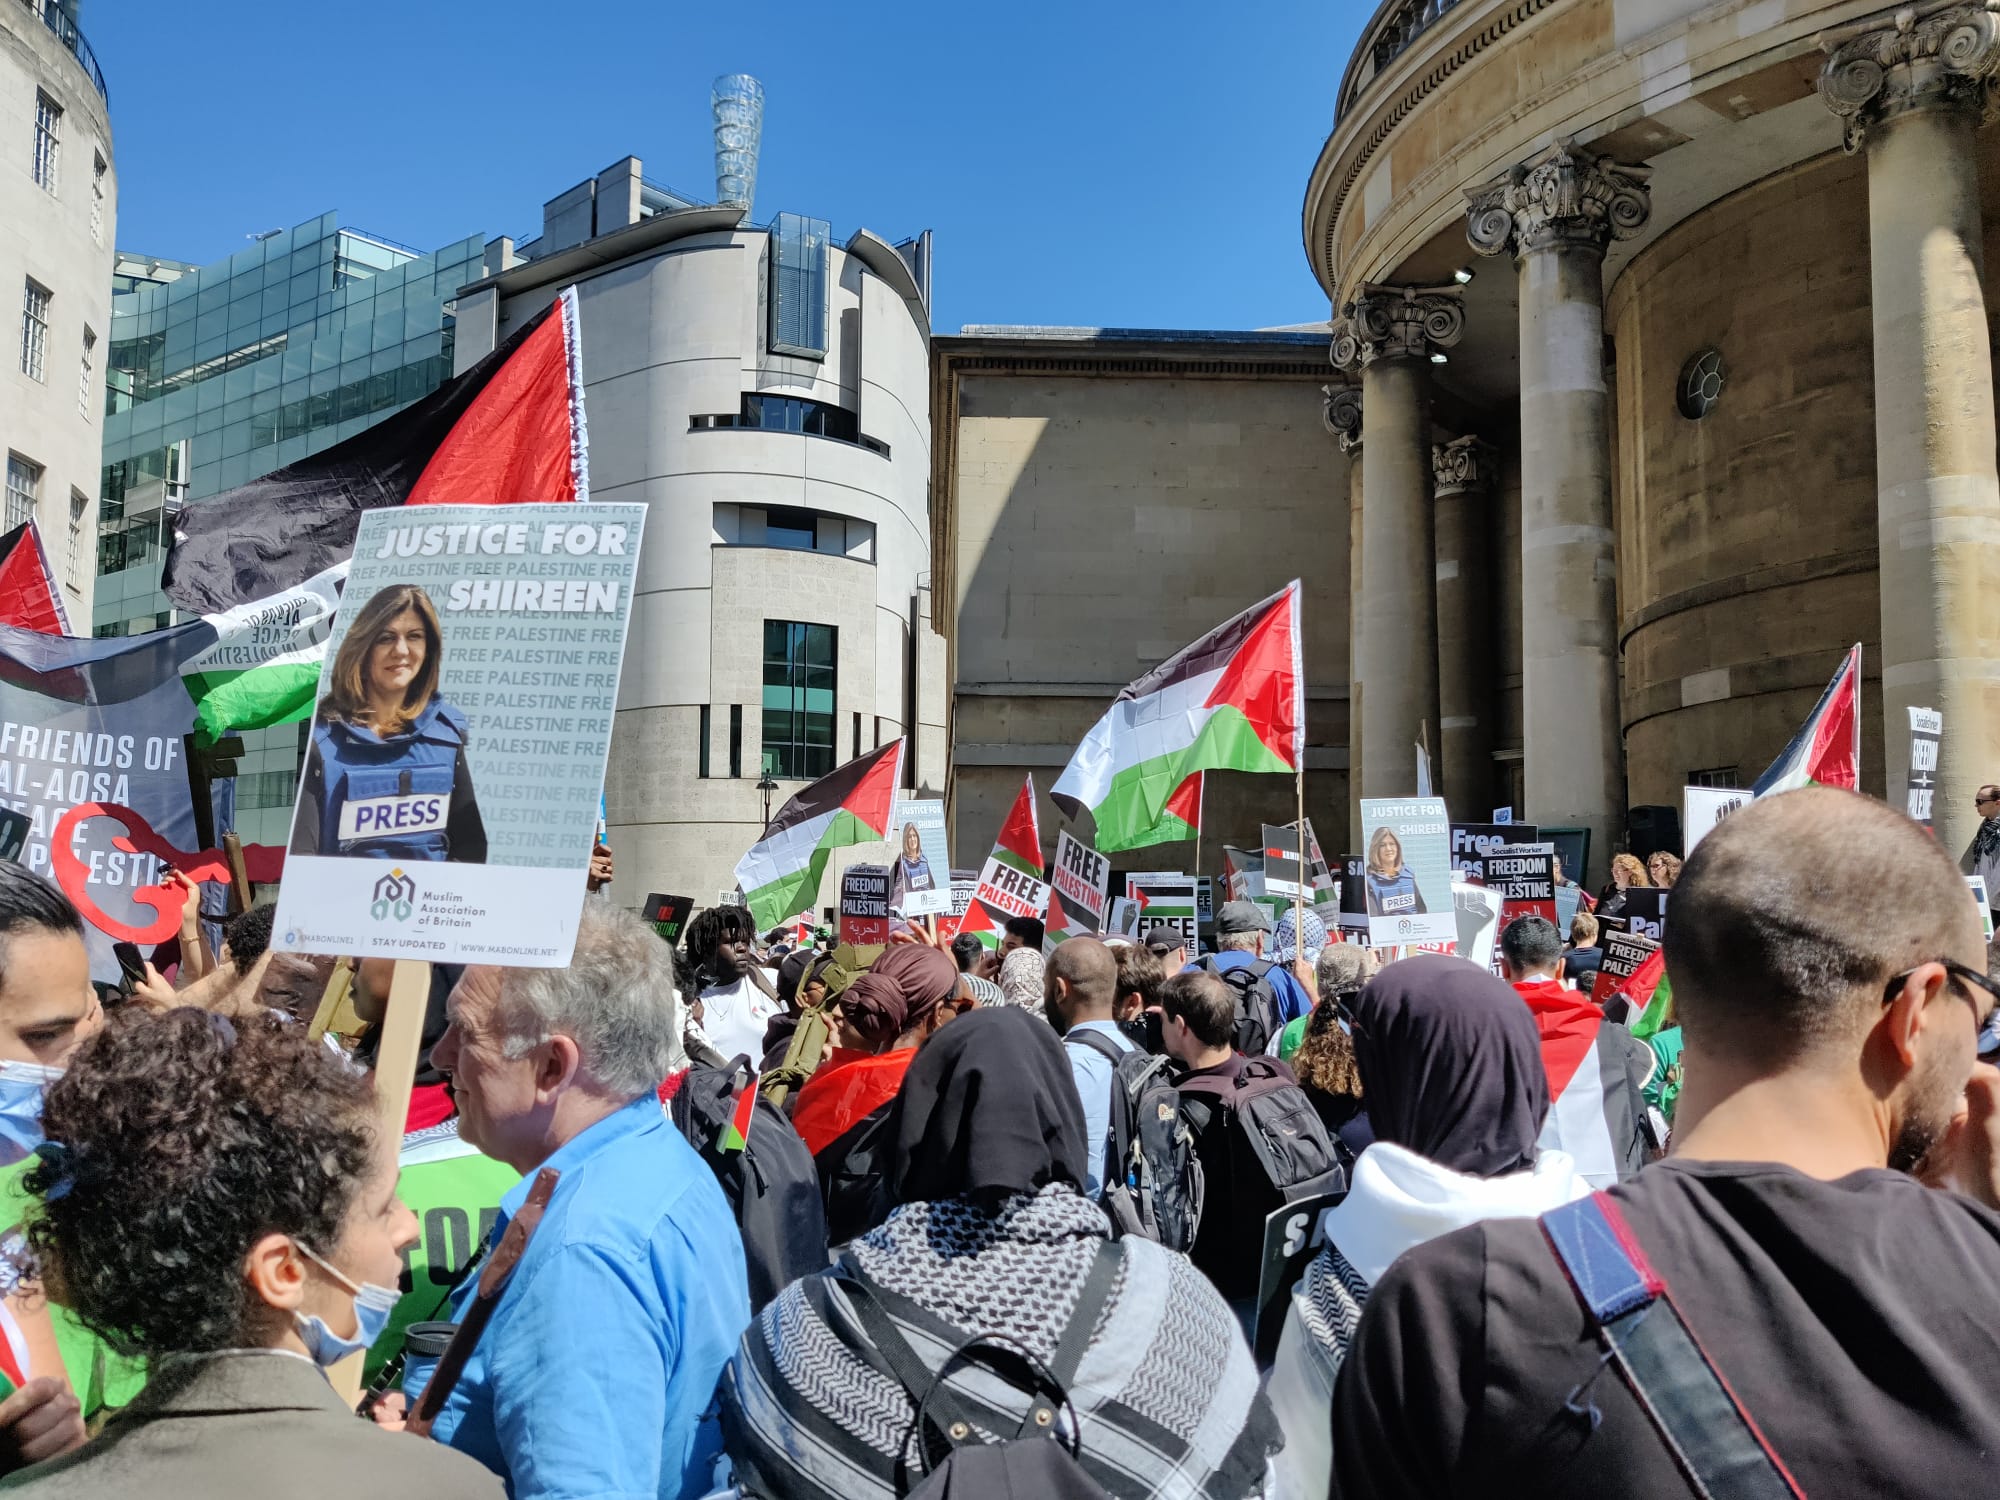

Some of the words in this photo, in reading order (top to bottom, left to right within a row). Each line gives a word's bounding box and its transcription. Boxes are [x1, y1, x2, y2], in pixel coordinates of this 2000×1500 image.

[378, 525, 528, 559] JUSTICE
[541, 524, 628, 556] FOR
[379, 562, 459, 578] PALESTINE
[464, 562, 502, 576] FREE
[507, 562, 597, 577] PALESTINE
[447, 579, 619, 613] SHIREEN
[452, 626, 492, 642] FREE
[495, 626, 587, 643] PALESTINE
[448, 648, 488, 662] FREE
[491, 649, 584, 665] PALESTINE
[444, 669, 484, 684] FREE
[487, 670, 580, 687] PALESTINE
[484, 692, 578, 710] PALESTINE
[480, 714, 574, 732] PALESTINE
[1, 721, 135, 769] FRIENDS
[144, 736, 179, 771] OF
[476, 737, 571, 756] PALESTINE
[473, 760, 567, 779] PALESTINE
[0, 760, 130, 807] AL-AQSA
[355, 799, 440, 833] PRESS
[902, 806, 928, 815] JUSTICE
[929, 805, 942, 814] FOR
[1371, 806, 1418, 817] JUSTICE
[1421, 805, 1443, 816] FOR
[1399, 824, 1445, 835] SHIREEN
[1452, 829, 1505, 853] Free
[1519, 846, 1543, 854] Worker
[1062, 837, 1104, 888] FREE
[1488, 858, 1547, 876] FREEDOM
[845, 877, 885, 893] FREEDOM
[990, 863, 1042, 904] FREE
[1513, 874, 1523, 882] for
[422, 891, 463, 902] Muslim
[1054, 865, 1104, 913] PALESTINE
[842, 899, 888, 916] PALESTINE
[977, 882, 1039, 918] PALESTINE
[1387, 895, 1413, 908] PRESS
[420, 904, 486, 917] Association
[418, 916, 430, 925] of
[433, 917, 471, 928] Britain
[372, 937, 396, 947] STAY
[399, 939, 446, 951] UPDATED
[461, 944, 558, 957] WWW.MABONLINE.NET
[1609, 943, 1653, 962] FREEDO
